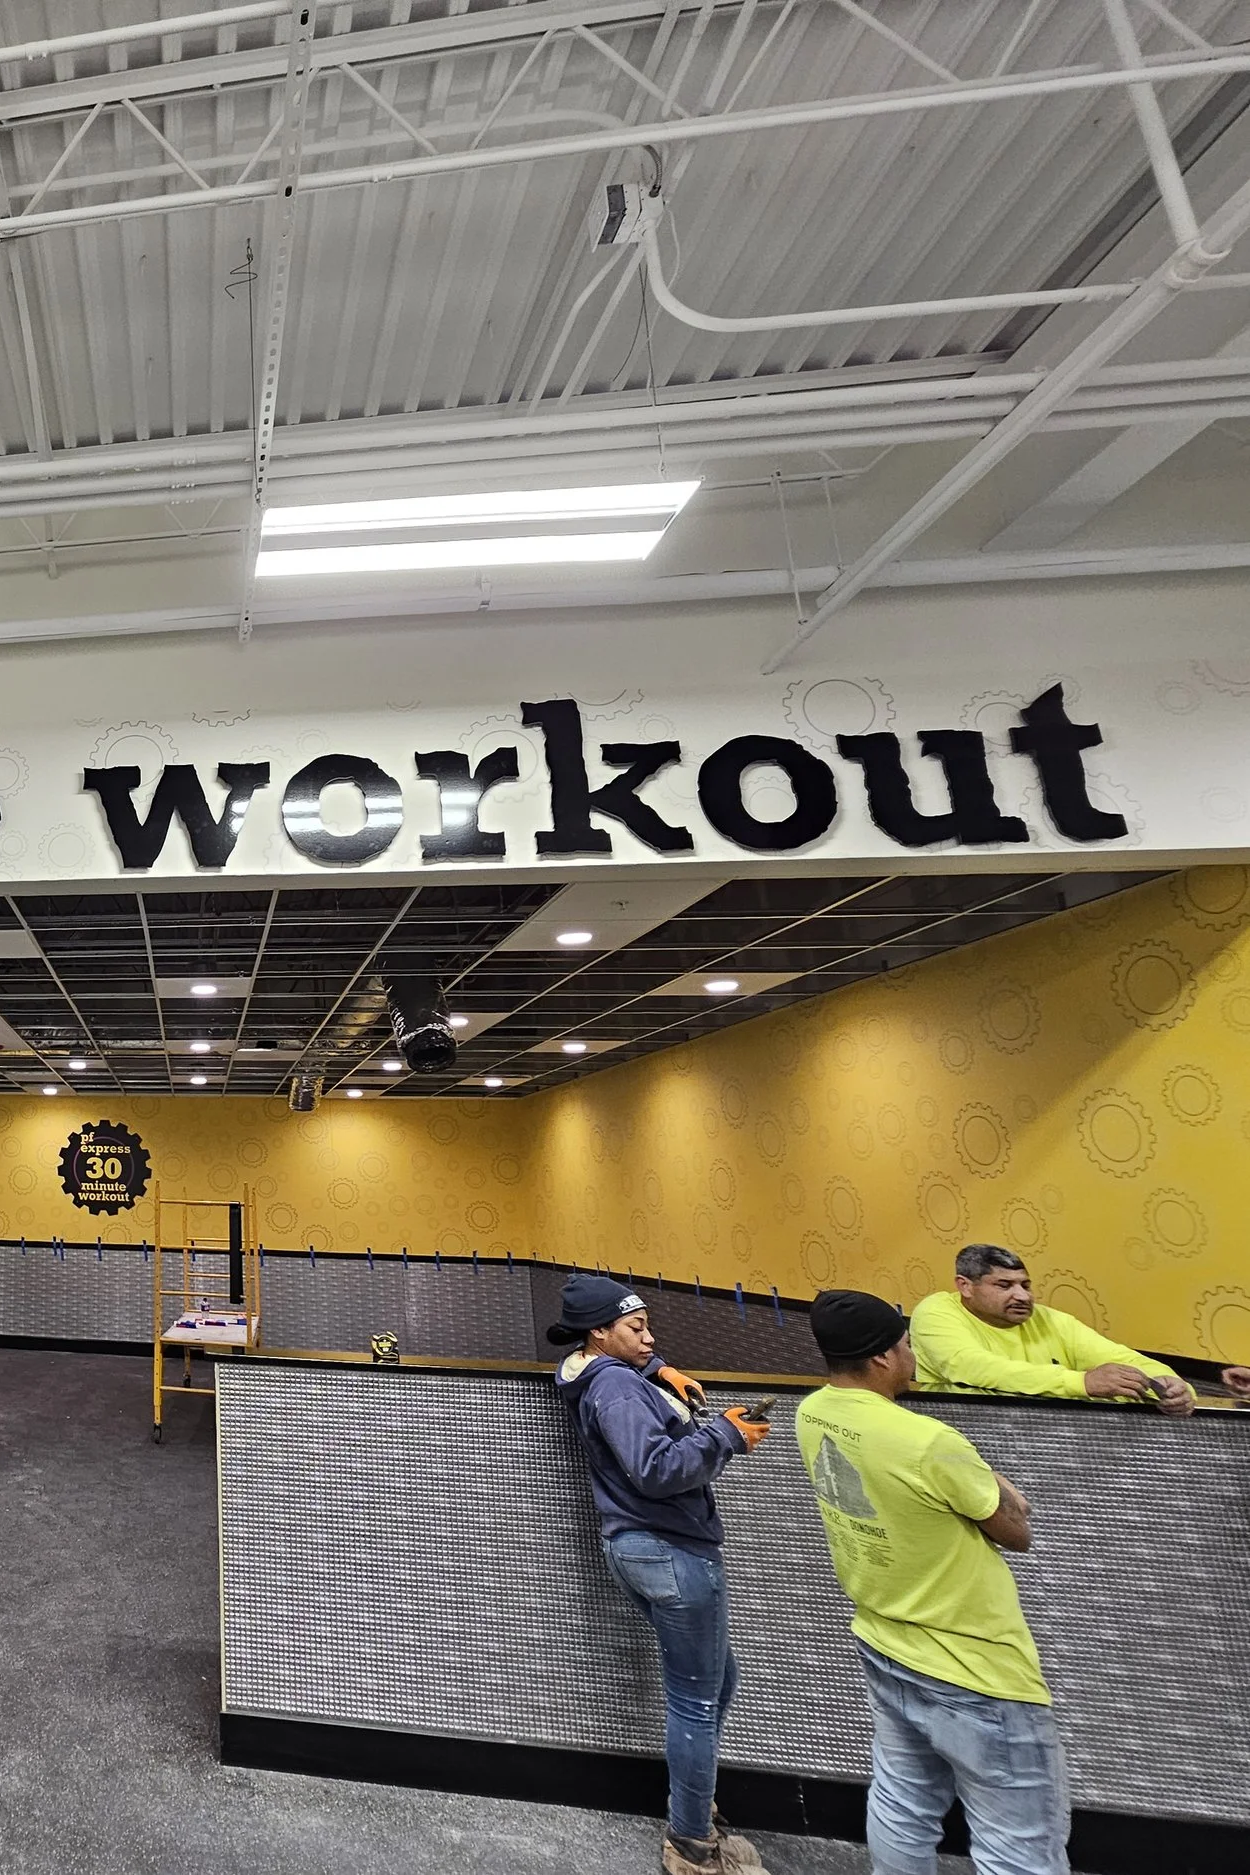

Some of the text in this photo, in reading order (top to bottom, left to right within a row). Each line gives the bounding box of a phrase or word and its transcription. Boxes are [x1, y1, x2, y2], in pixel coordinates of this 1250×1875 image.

[82, 683, 1127, 870] workout
[80, 1132, 95, 1144] pf
[80, 1145, 131, 1156] express
[85, 1157, 122, 1179] 30
[81, 1181, 127, 1192] minute
[78, 1191, 130, 1202] workout
[801, 1413, 862, 1442] TOPPING OUT
[849, 1519, 888, 1540] DONOHOE
